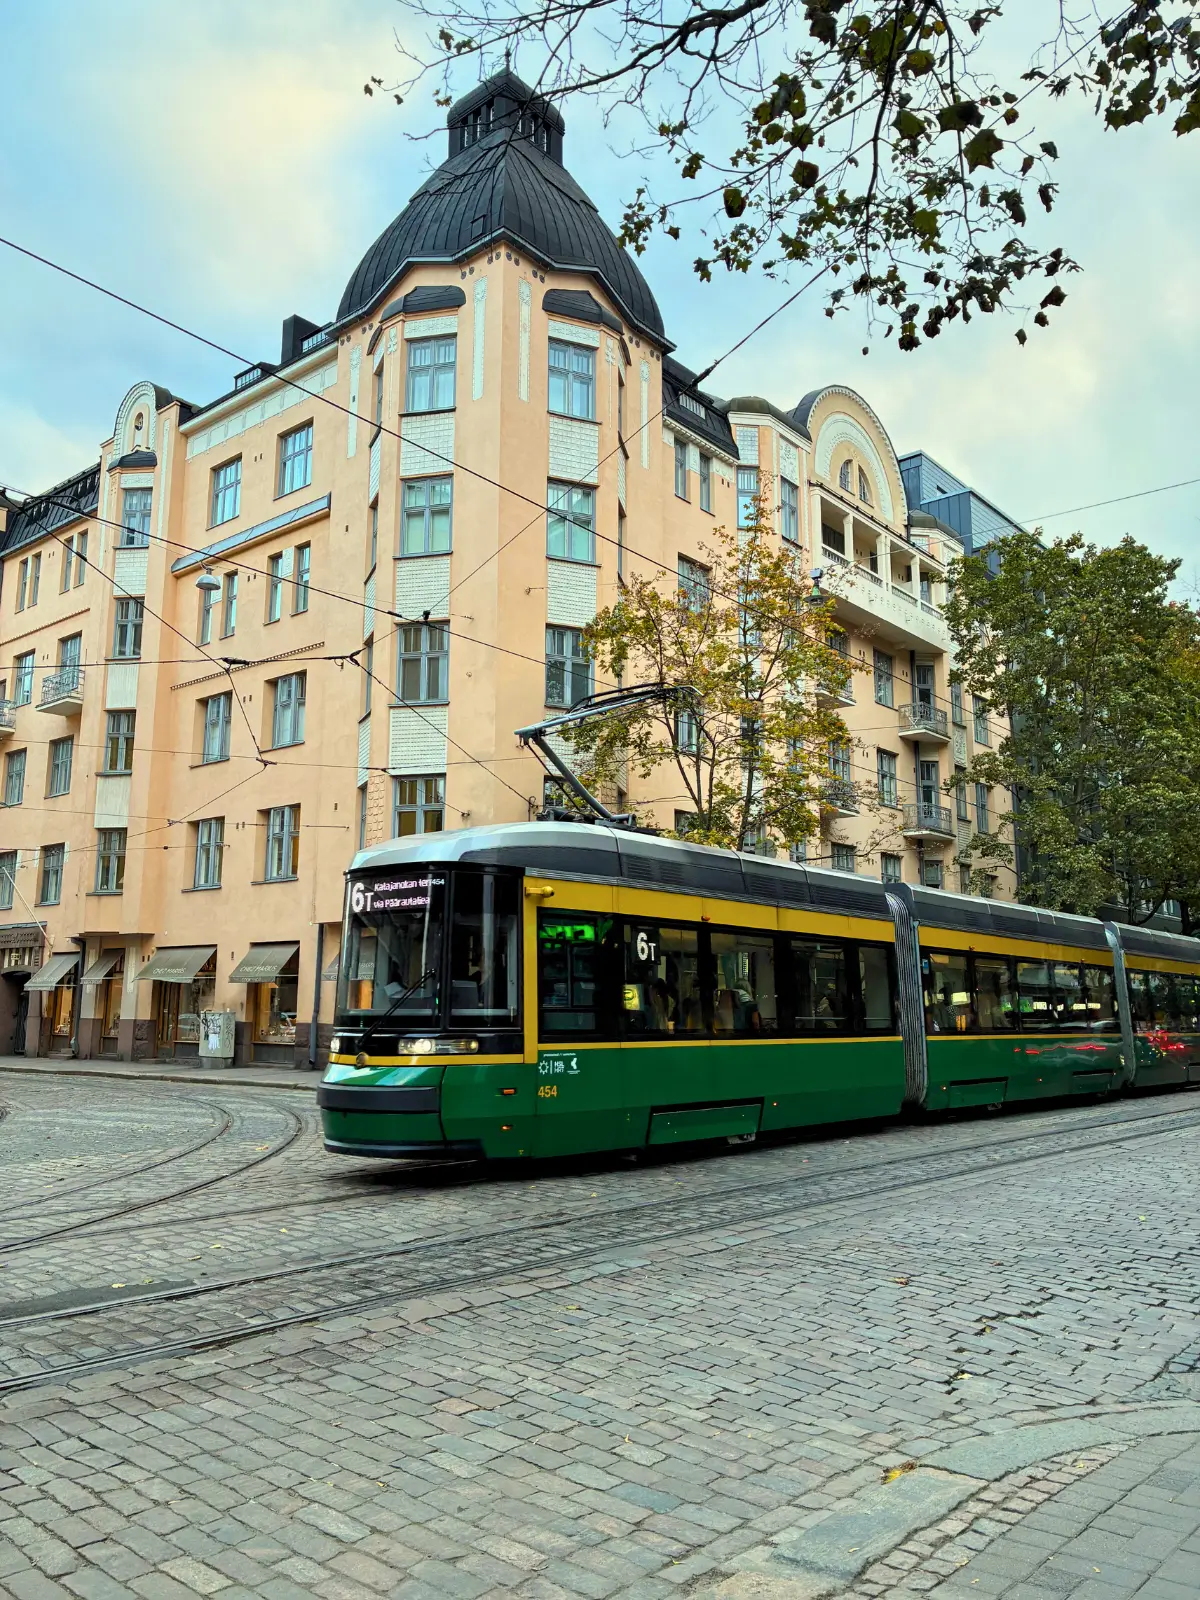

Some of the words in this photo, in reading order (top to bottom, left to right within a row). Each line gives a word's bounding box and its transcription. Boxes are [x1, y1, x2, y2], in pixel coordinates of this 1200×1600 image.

[374, 880, 417, 892] Katajanokan
[373, 899, 384, 909] via
[537, 1085, 558, 1098] 454
